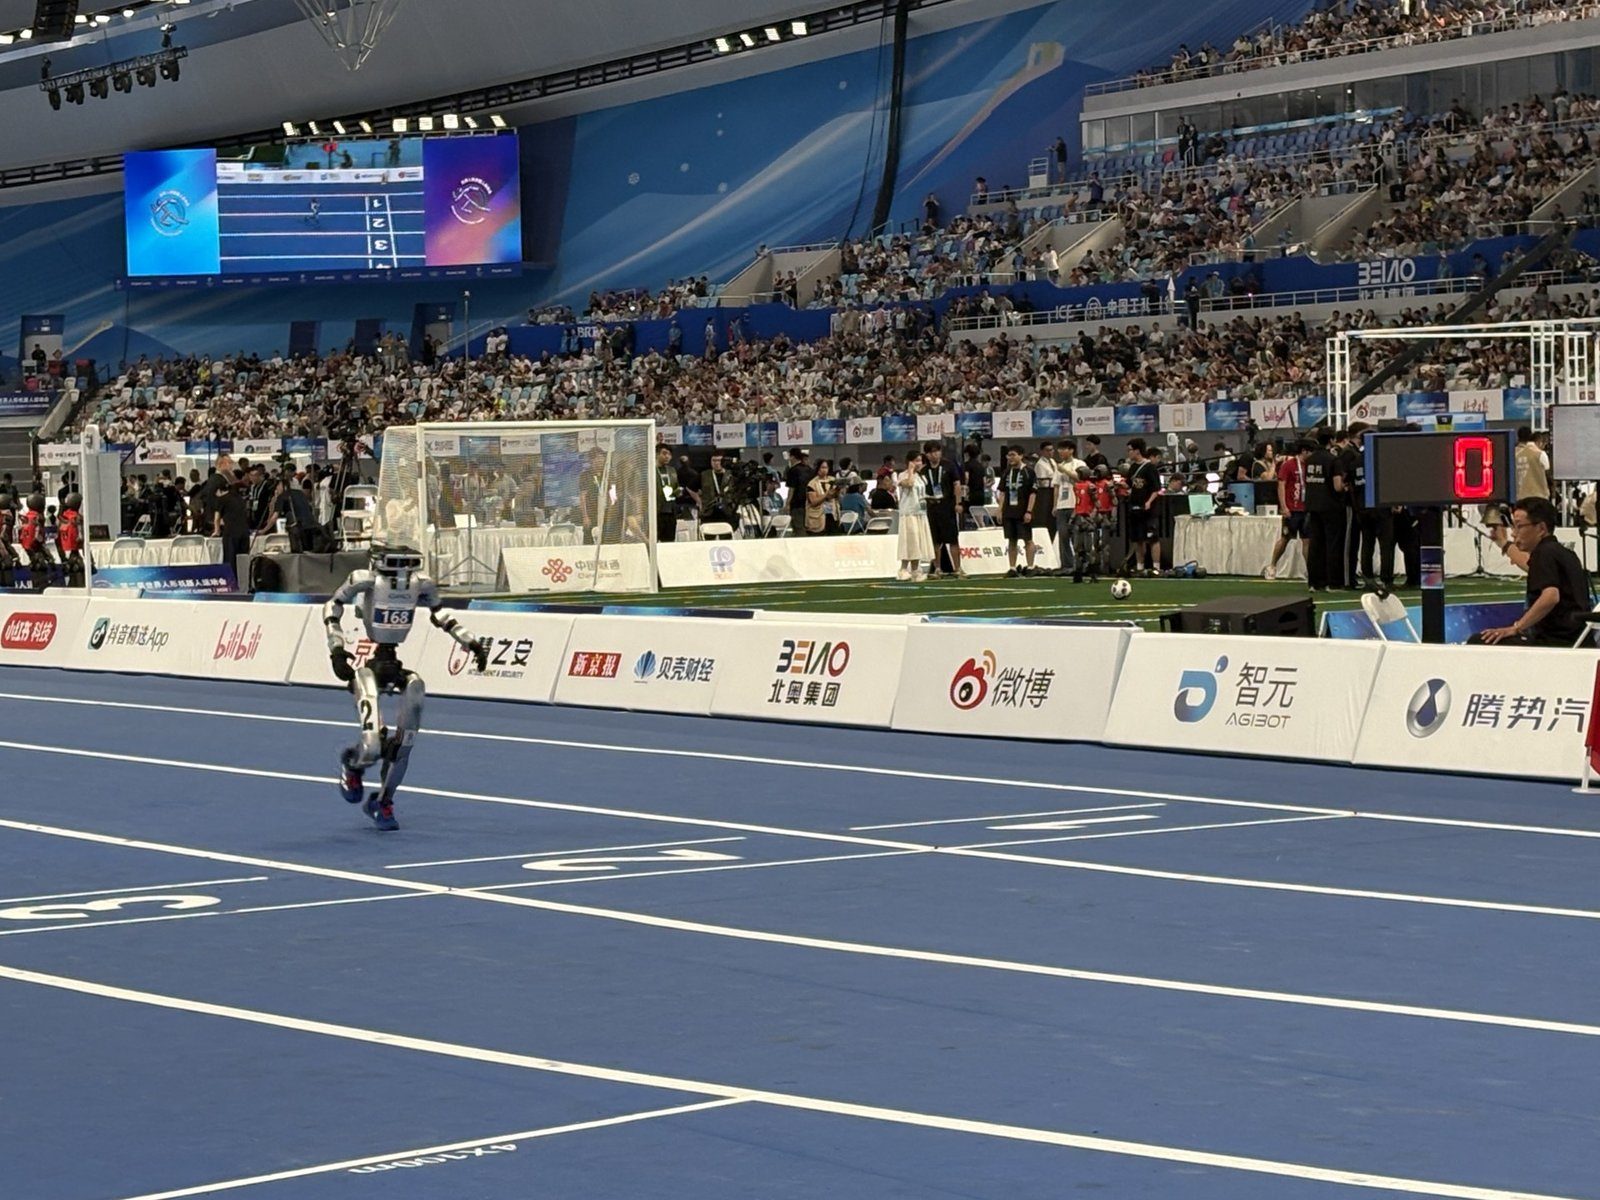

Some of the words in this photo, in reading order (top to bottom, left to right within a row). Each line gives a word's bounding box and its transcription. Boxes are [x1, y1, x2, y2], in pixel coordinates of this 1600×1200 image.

[1358, 258, 1416, 285] BEIAO
[1454, 436, 1494, 499] 0
[381, 609, 410, 625] 168
[105, 623, 169, 652] 抖音精选App
[213, 619, 263, 660] bilibili
[571, 653, 617, 678] 新京报
[656, 657, 715, 683] 贝壳财经
[776, 640, 850, 677] BEIAO
[767, 678, 842, 707] 北奥集团
[991, 668, 1056, 709] 微博
[1235, 661, 1298, 708] 智元
[360, 699, 374, 731] 2
[1225, 712, 1292, 729] AGIBOT
